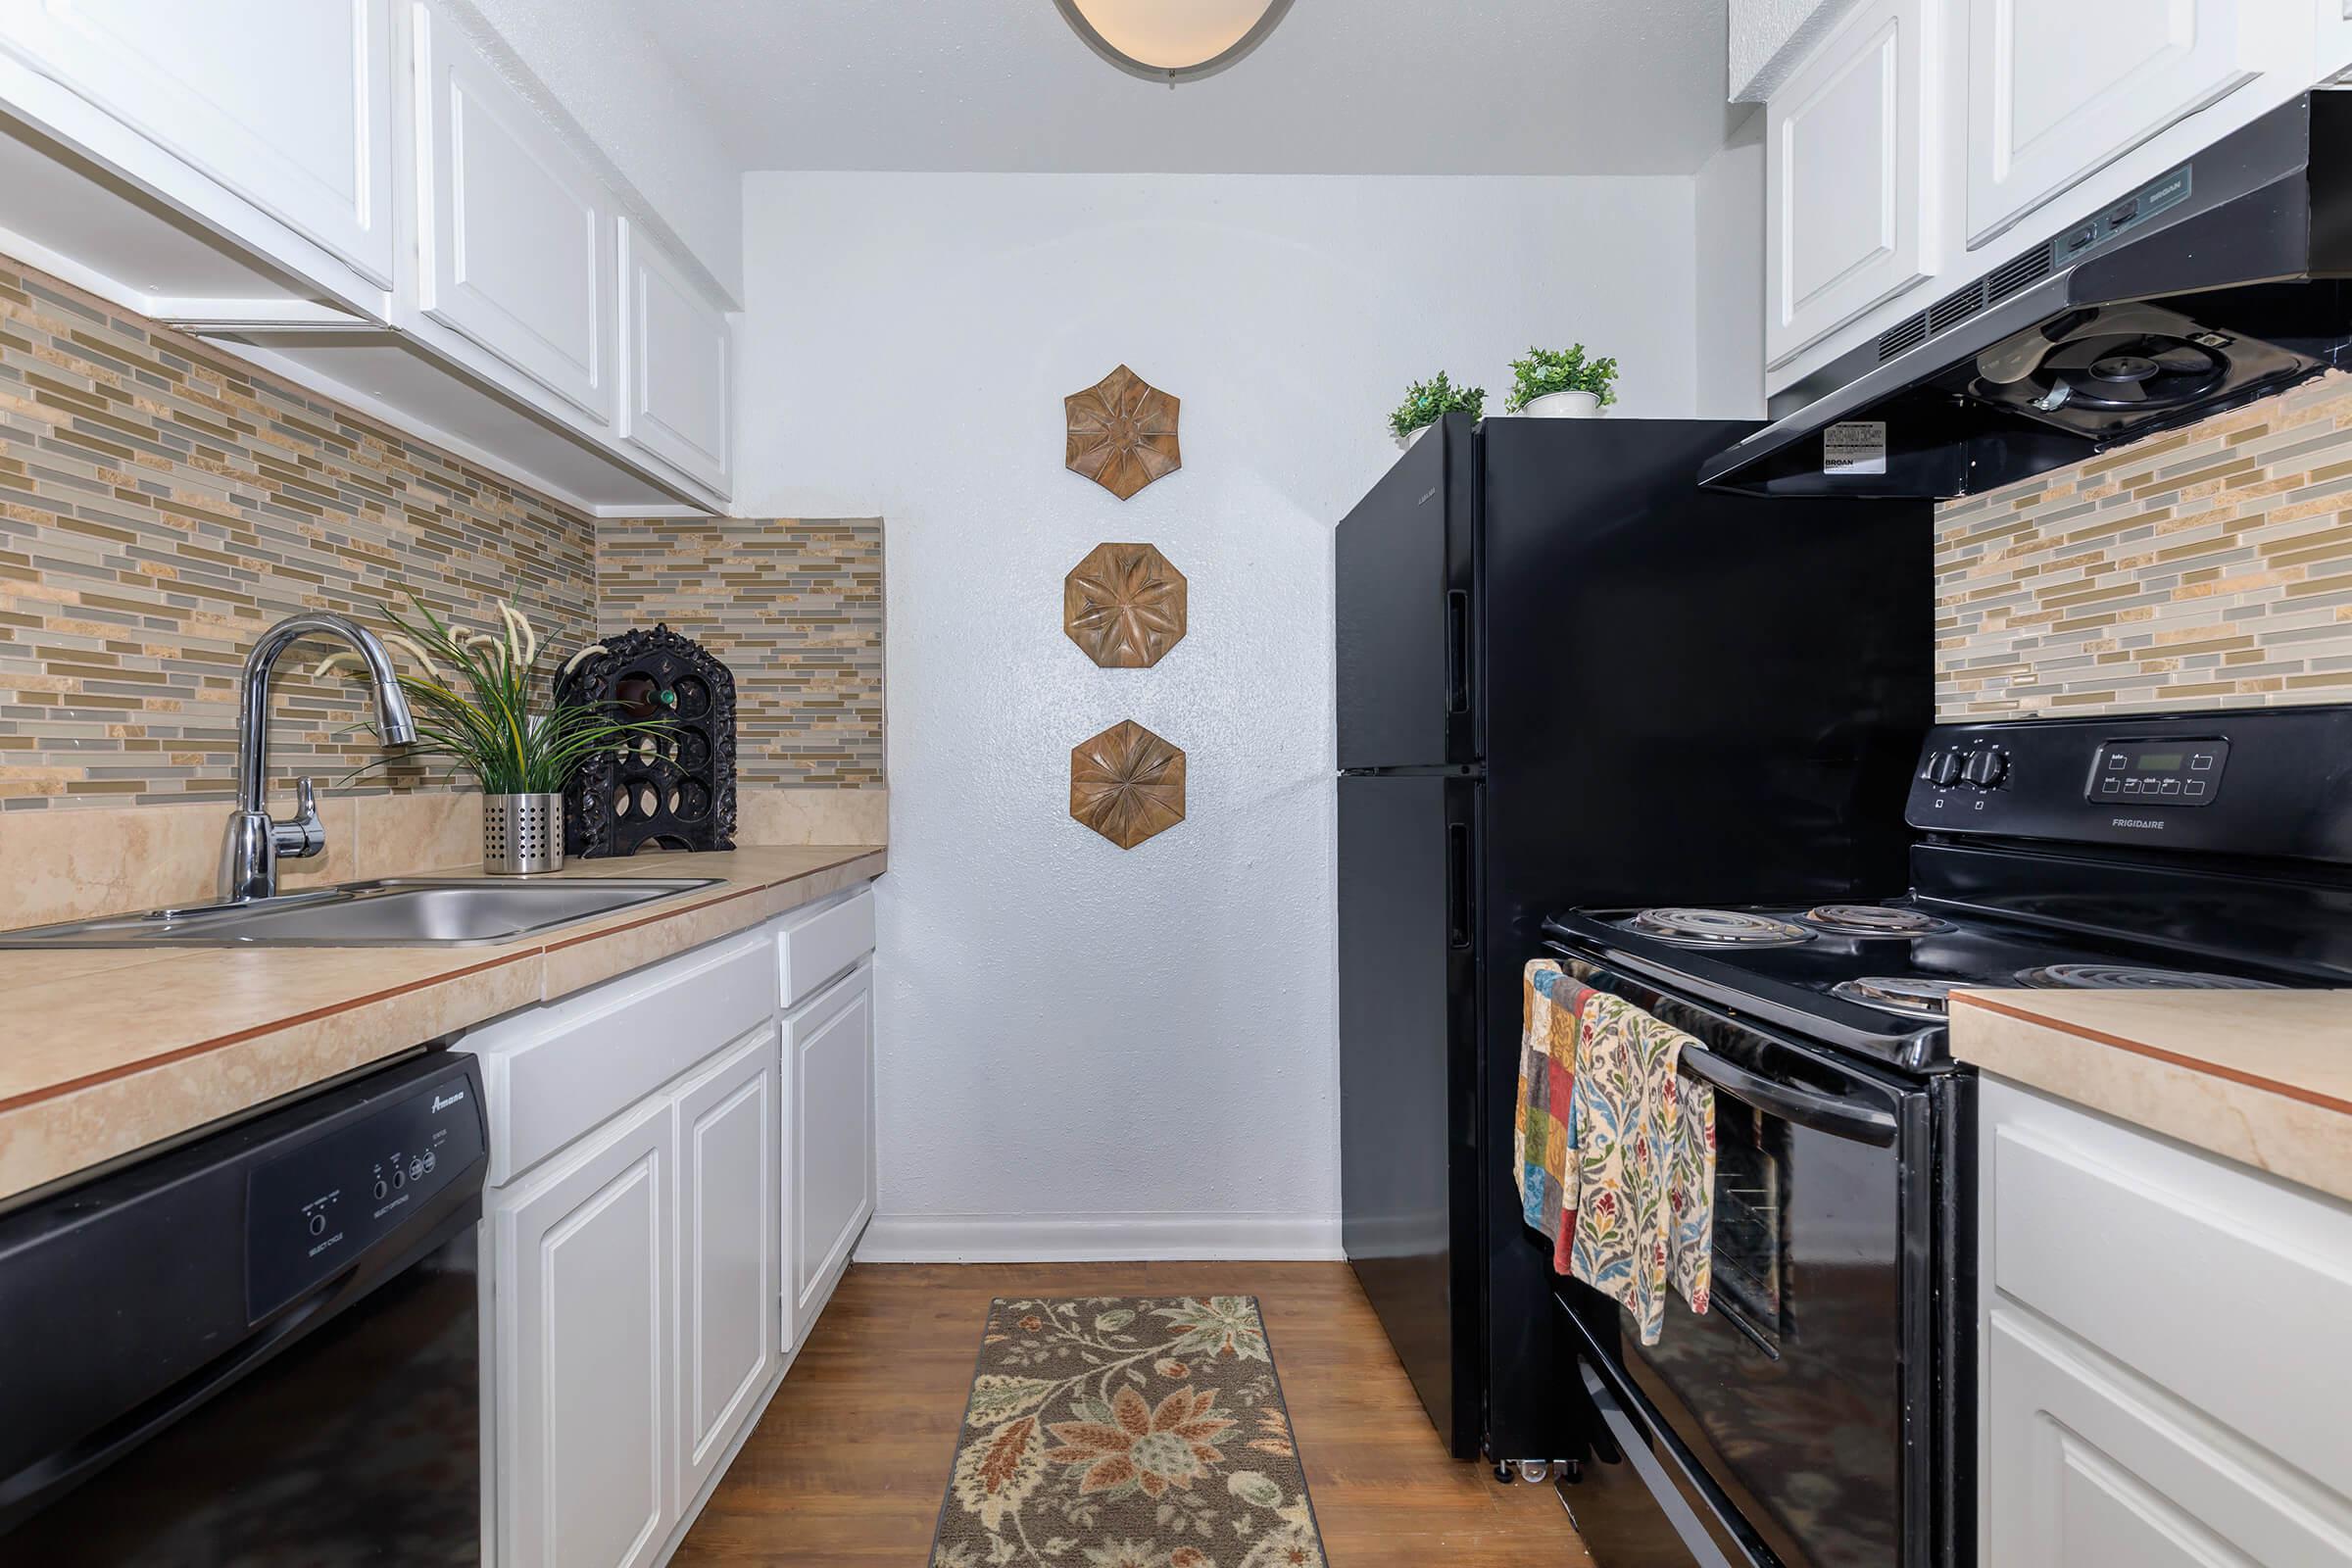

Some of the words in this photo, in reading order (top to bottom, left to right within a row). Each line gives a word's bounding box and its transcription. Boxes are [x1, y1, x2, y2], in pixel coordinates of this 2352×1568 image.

[2150, 180, 2181, 204] BROAN
[2112, 818, 2165, 829] FRIGIDAIRE
[431, 1091, 465, 1113] Amana
